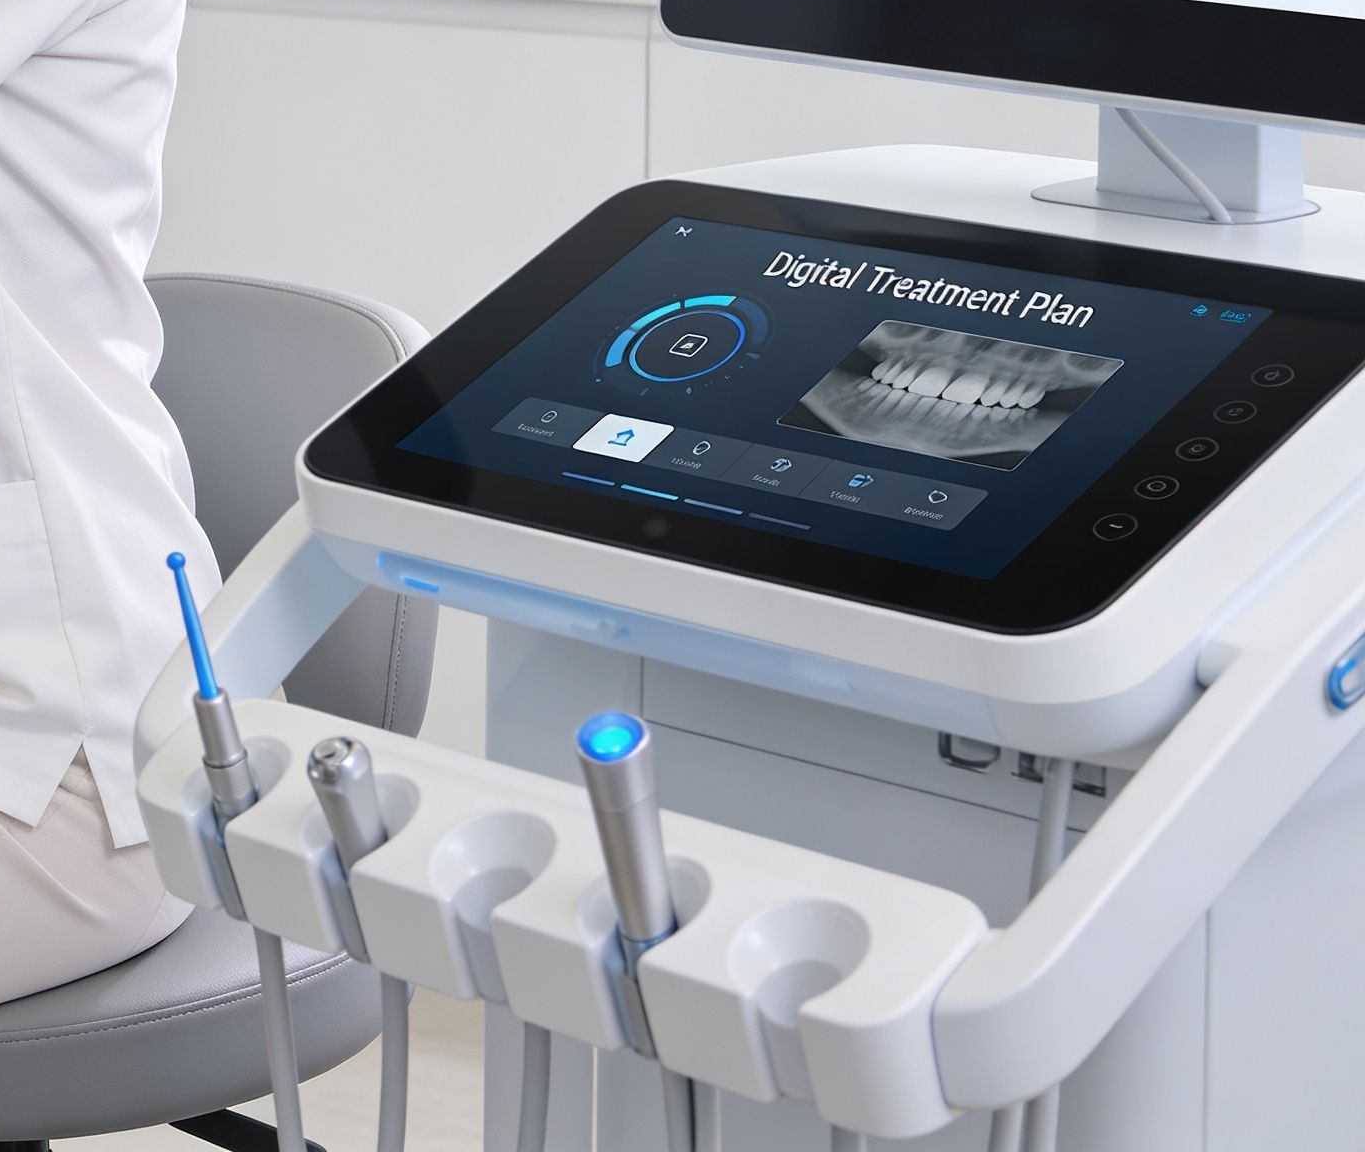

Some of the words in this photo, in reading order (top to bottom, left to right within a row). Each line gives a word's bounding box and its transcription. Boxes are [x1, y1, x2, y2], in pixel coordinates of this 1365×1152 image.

[763, 250, 868, 288] Digital
[866, 265, 1021, 317] Treatment
[1018, 290, 1095, 328] Plan
